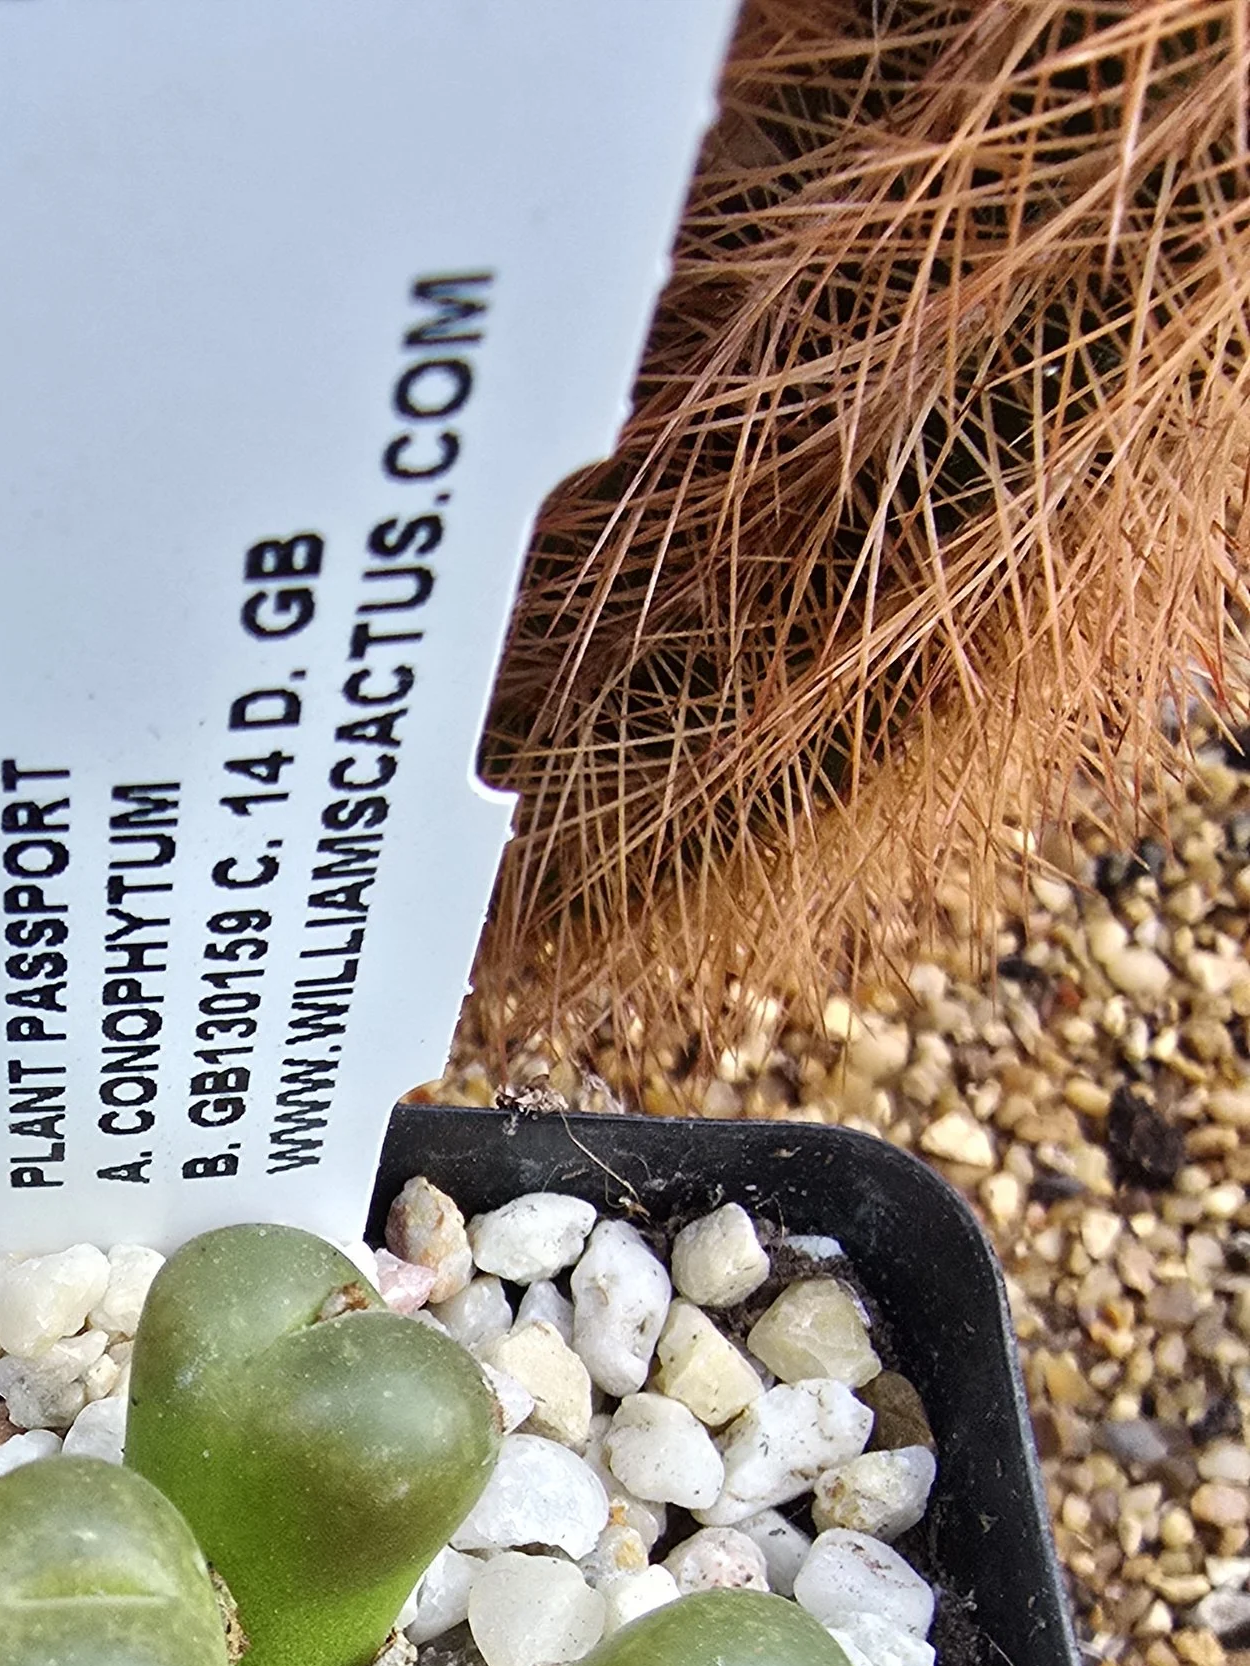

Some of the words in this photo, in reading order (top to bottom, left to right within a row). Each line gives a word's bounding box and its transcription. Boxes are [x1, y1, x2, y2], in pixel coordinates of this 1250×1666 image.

[239, 531, 327, 641] GB
[227, 668, 309, 731] D.
[264, 270, 495, 1176] WWW.WILLIAMSCACTUS.COM
[218, 749, 296, 817] 14
[0, 756, 72, 1043] PASSPORT
[210, 838, 284, 891] C.
[97, 780, 182, 1137] CONOPHYTUM
[186, 907, 274, 1129] GB130159
[8, 1057, 68, 1189] PLANT
[95, 1150, 154, 1185] A.
[180, 1141, 242, 1181] B.
